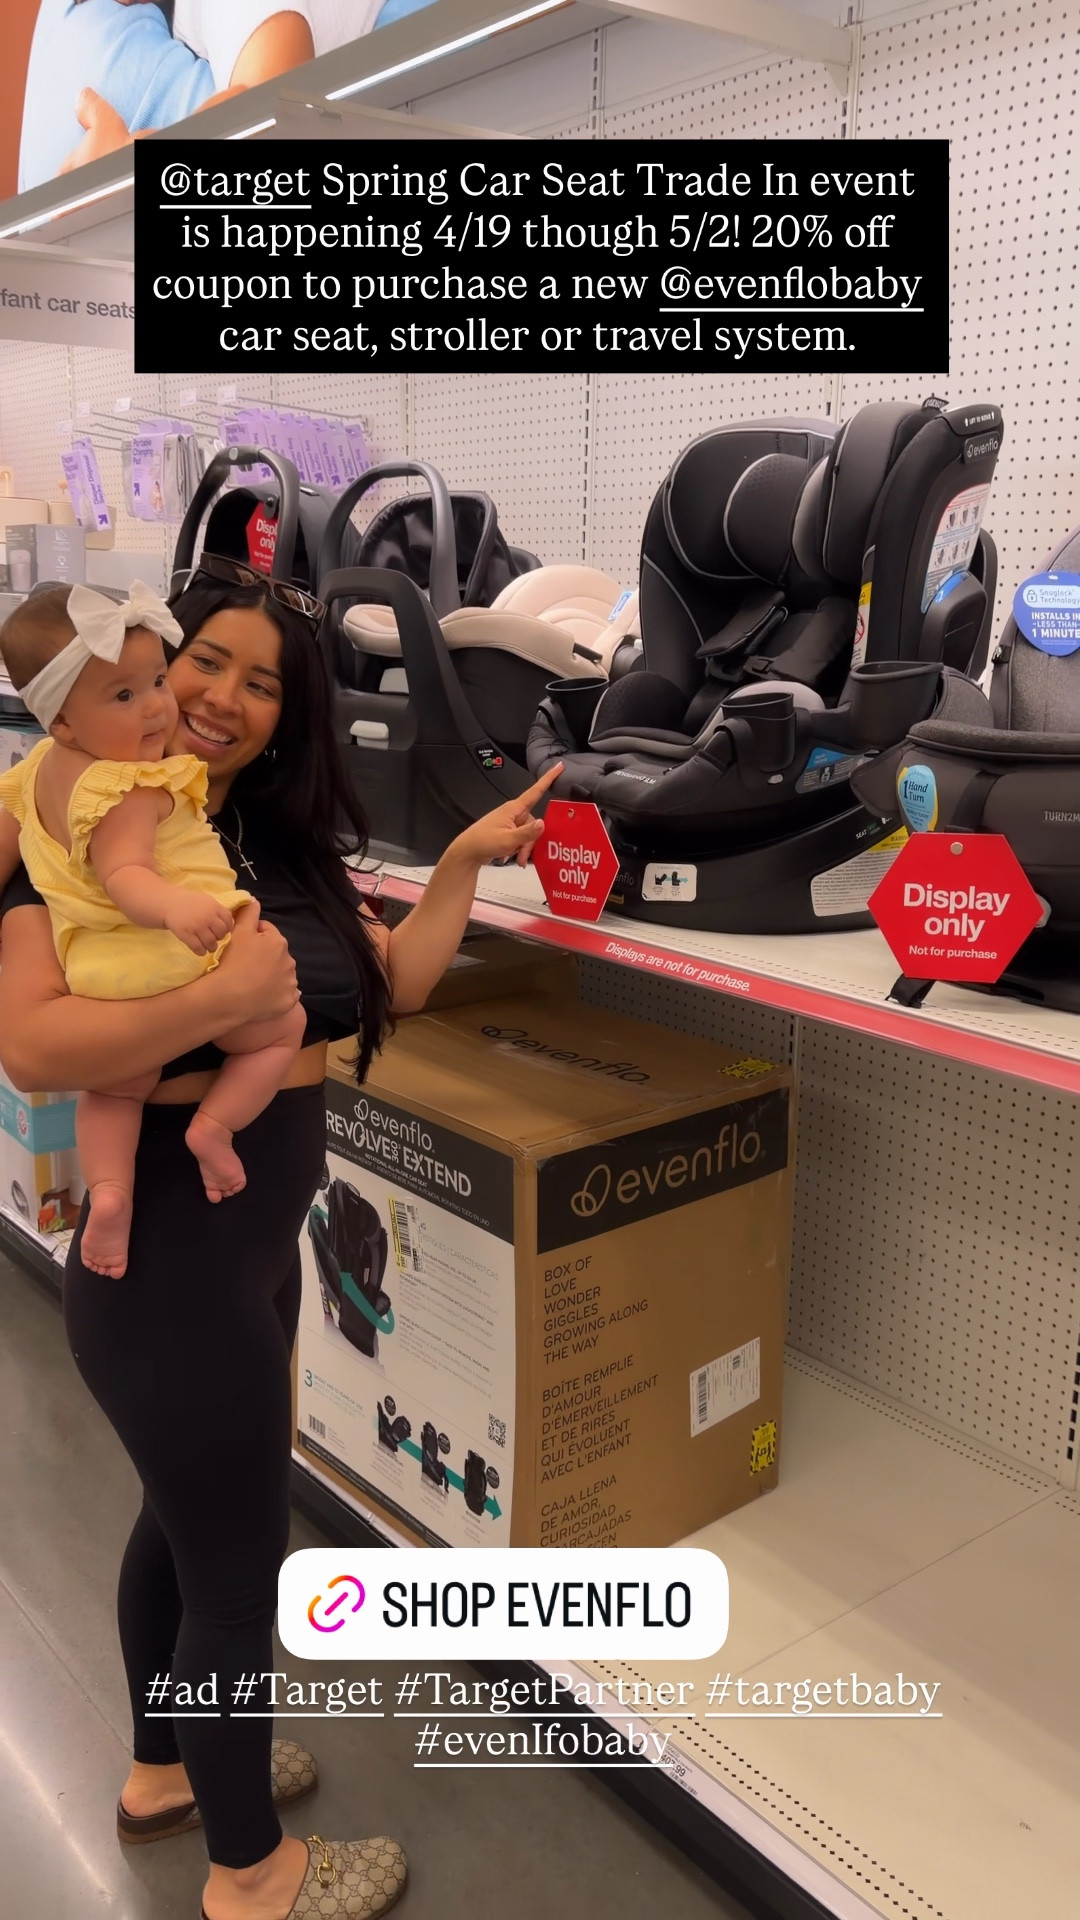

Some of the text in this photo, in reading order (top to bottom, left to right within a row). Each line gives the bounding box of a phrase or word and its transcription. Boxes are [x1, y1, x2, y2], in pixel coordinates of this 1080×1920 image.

[47, 297, 80, 313] car
[86, 302, 135, 319] seats
[974, 438, 998, 456] evenflo
[1032, 612, 1070, 620] INSTALLS
[1032, 628, 1080, 638] 1 MINUTE
[909, 781, 928, 793] Hand
[909, 791, 925, 803] Turn
[548, 841, 601, 870] Display
[559, 866, 589, 890] only
[552, 890, 598, 904] Not for purchase
[904, 882, 1011, 916] Display
[924, 914, 986, 943] only
[605, 942, 751, 992] Displays are not for purchase.
[909, 946, 998, 960] Not for purchase
[326, 1110, 392, 1160] REVOLVE
[404, 1146, 472, 1197] EXTEND
[544, 1256, 592, 1282] BOX OF
[544, 1278, 576, 1299] LOVE
[544, 1286, 600, 1316] WONDER
[544, 1303, 598, 1332] GIGGLES
[544, 1299, 648, 1348] GROWING ALONG
[544, 1334, 598, 1365] THE WAY
[304, 1369, 312, 1388] 3
[584, 1354, 634, 1386] REMPLIE
[542, 1385, 601, 1419] D'AMOUR
[540, 1418, 630, 1467] QUI ÉVOLUENT
[542, 1410, 616, 1452] ET DE RIRES
[540, 1433, 632, 1484] AVEC L'ENFANT
[541, 1474, 617, 1516] CAJA LLENA
[540, 1516, 558, 1533] DE
[540, 1504, 616, 1547] CURIOSIDAD
[556, 1510, 632, 1548] ARCAJADAS
